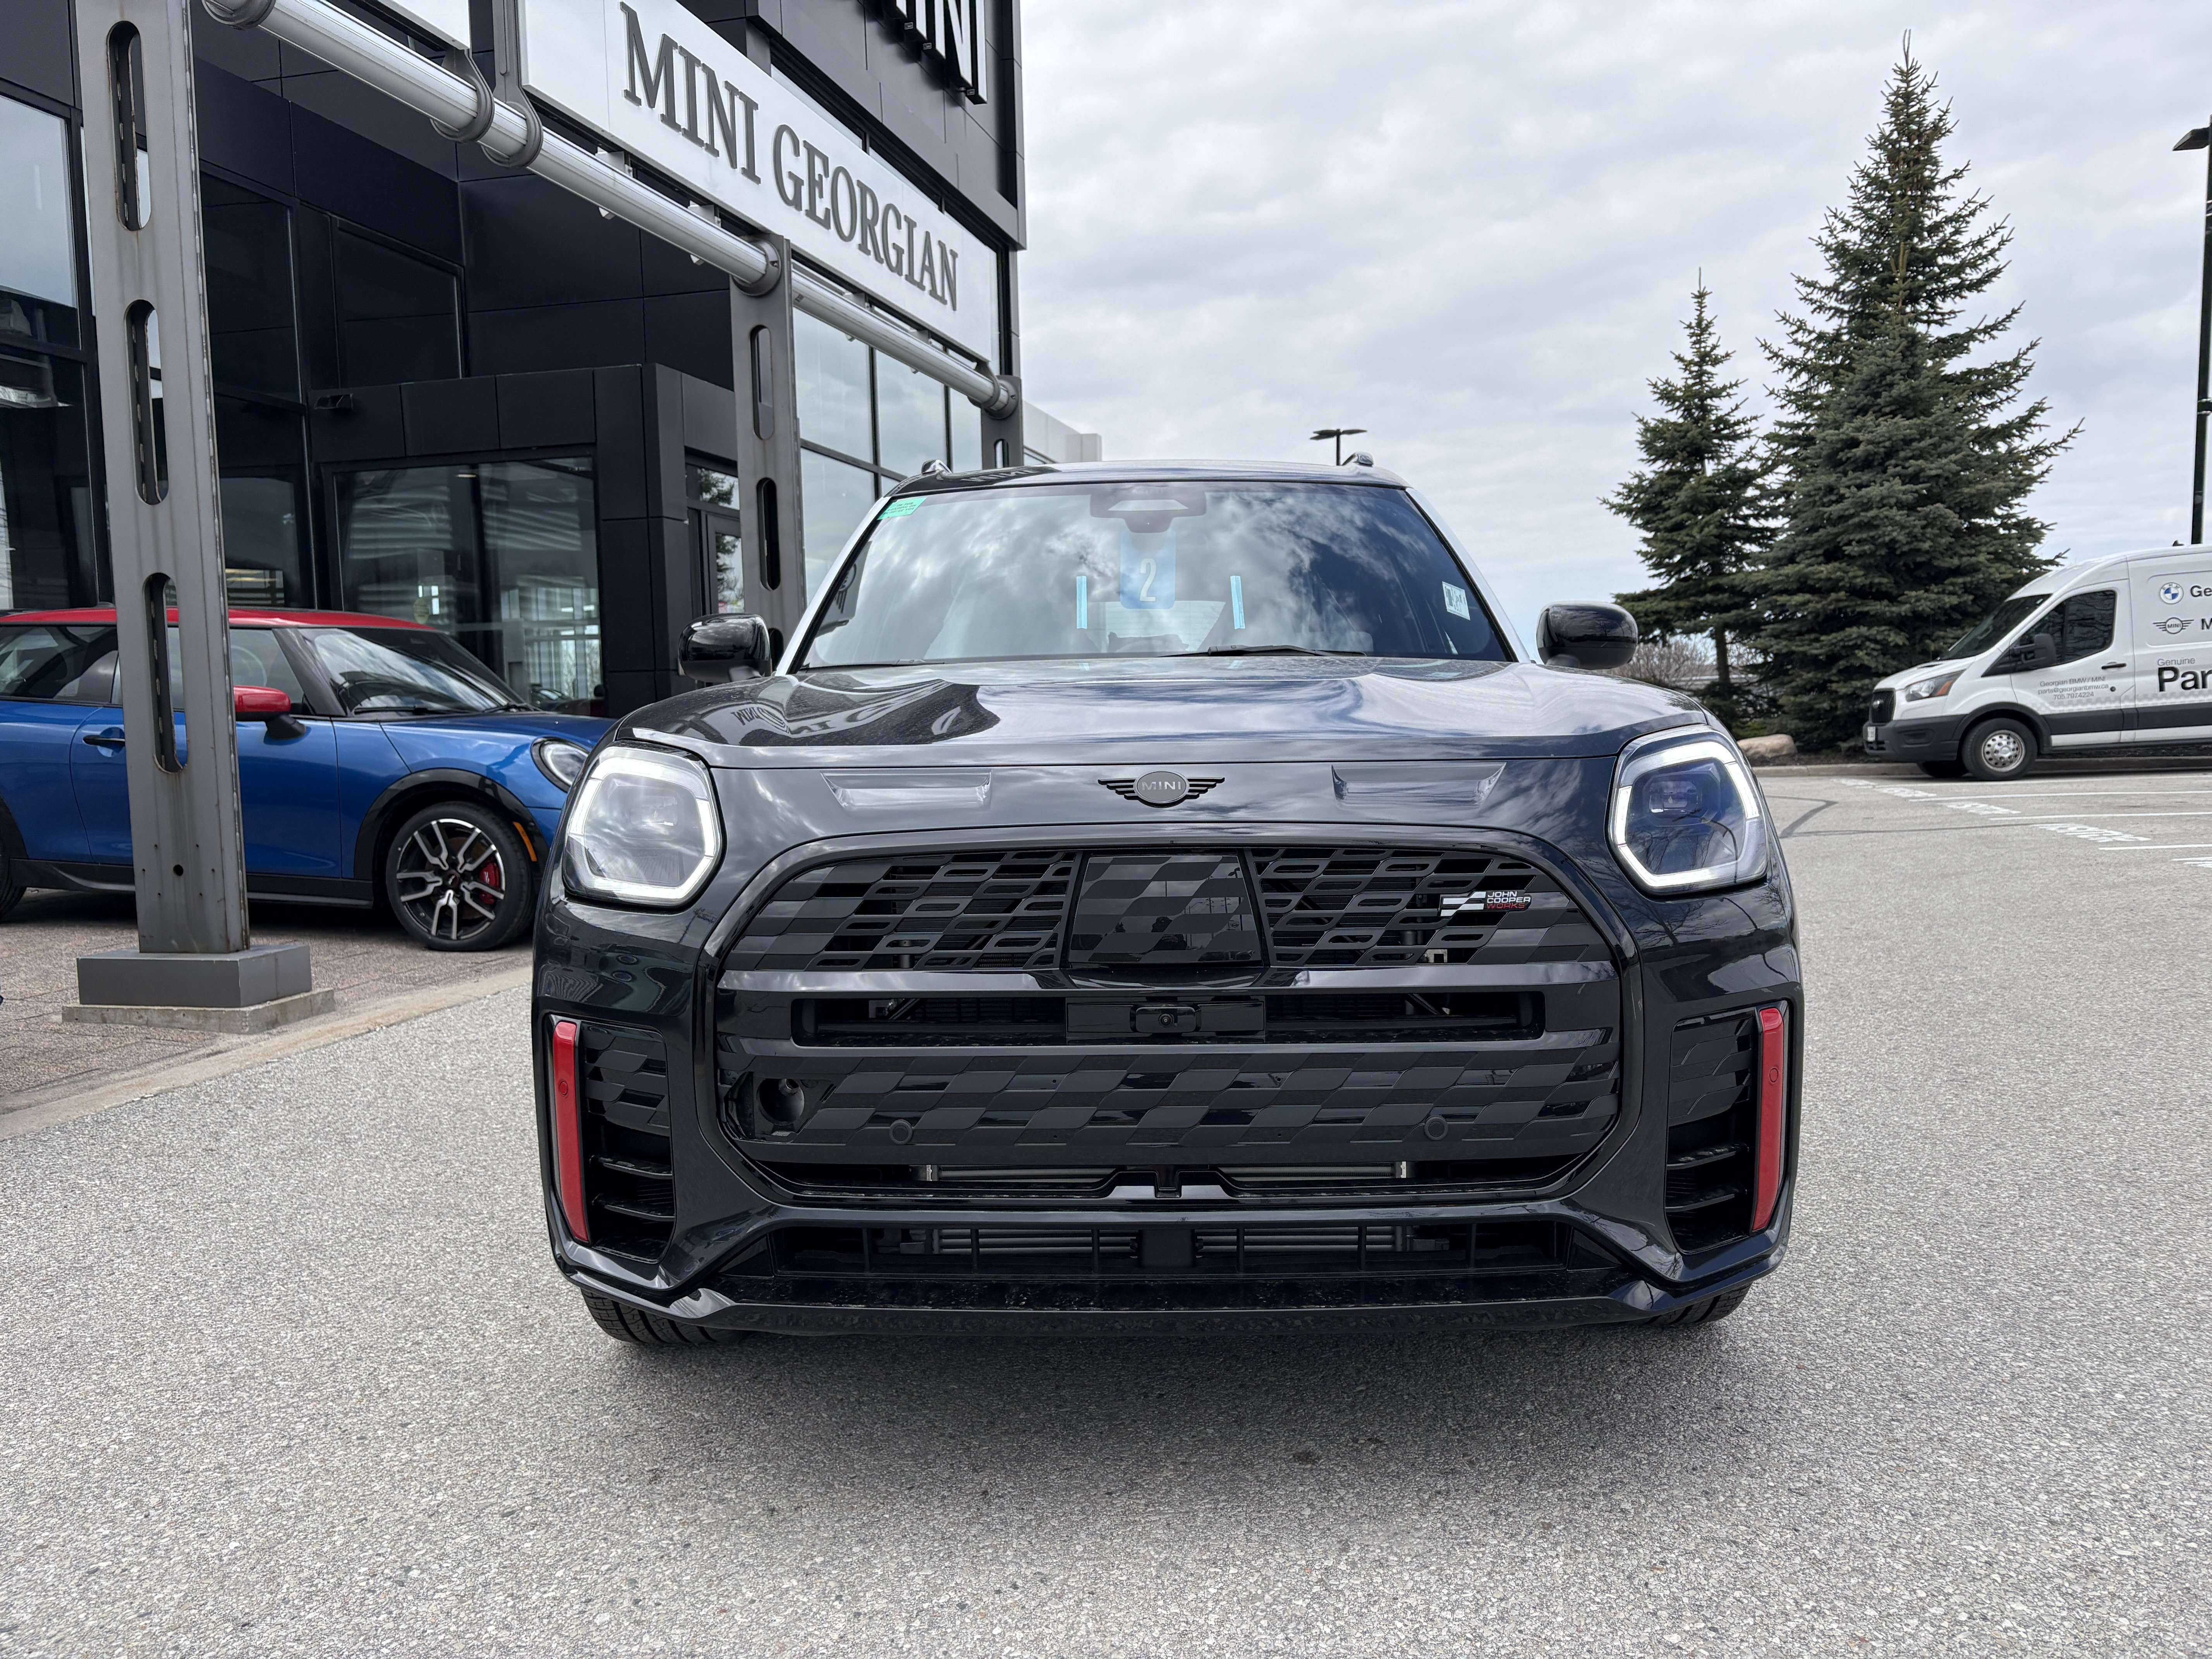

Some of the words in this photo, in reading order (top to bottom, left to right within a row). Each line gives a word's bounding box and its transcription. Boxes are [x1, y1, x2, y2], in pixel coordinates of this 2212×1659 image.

[620, 1, 761, 185] MINI
[773, 124, 958, 311] GEORGIAN
[1140, 558, 1156, 601] 2
[2157, 658, 2195, 666] Genuine
[1142, 781, 1181, 790] MINI
